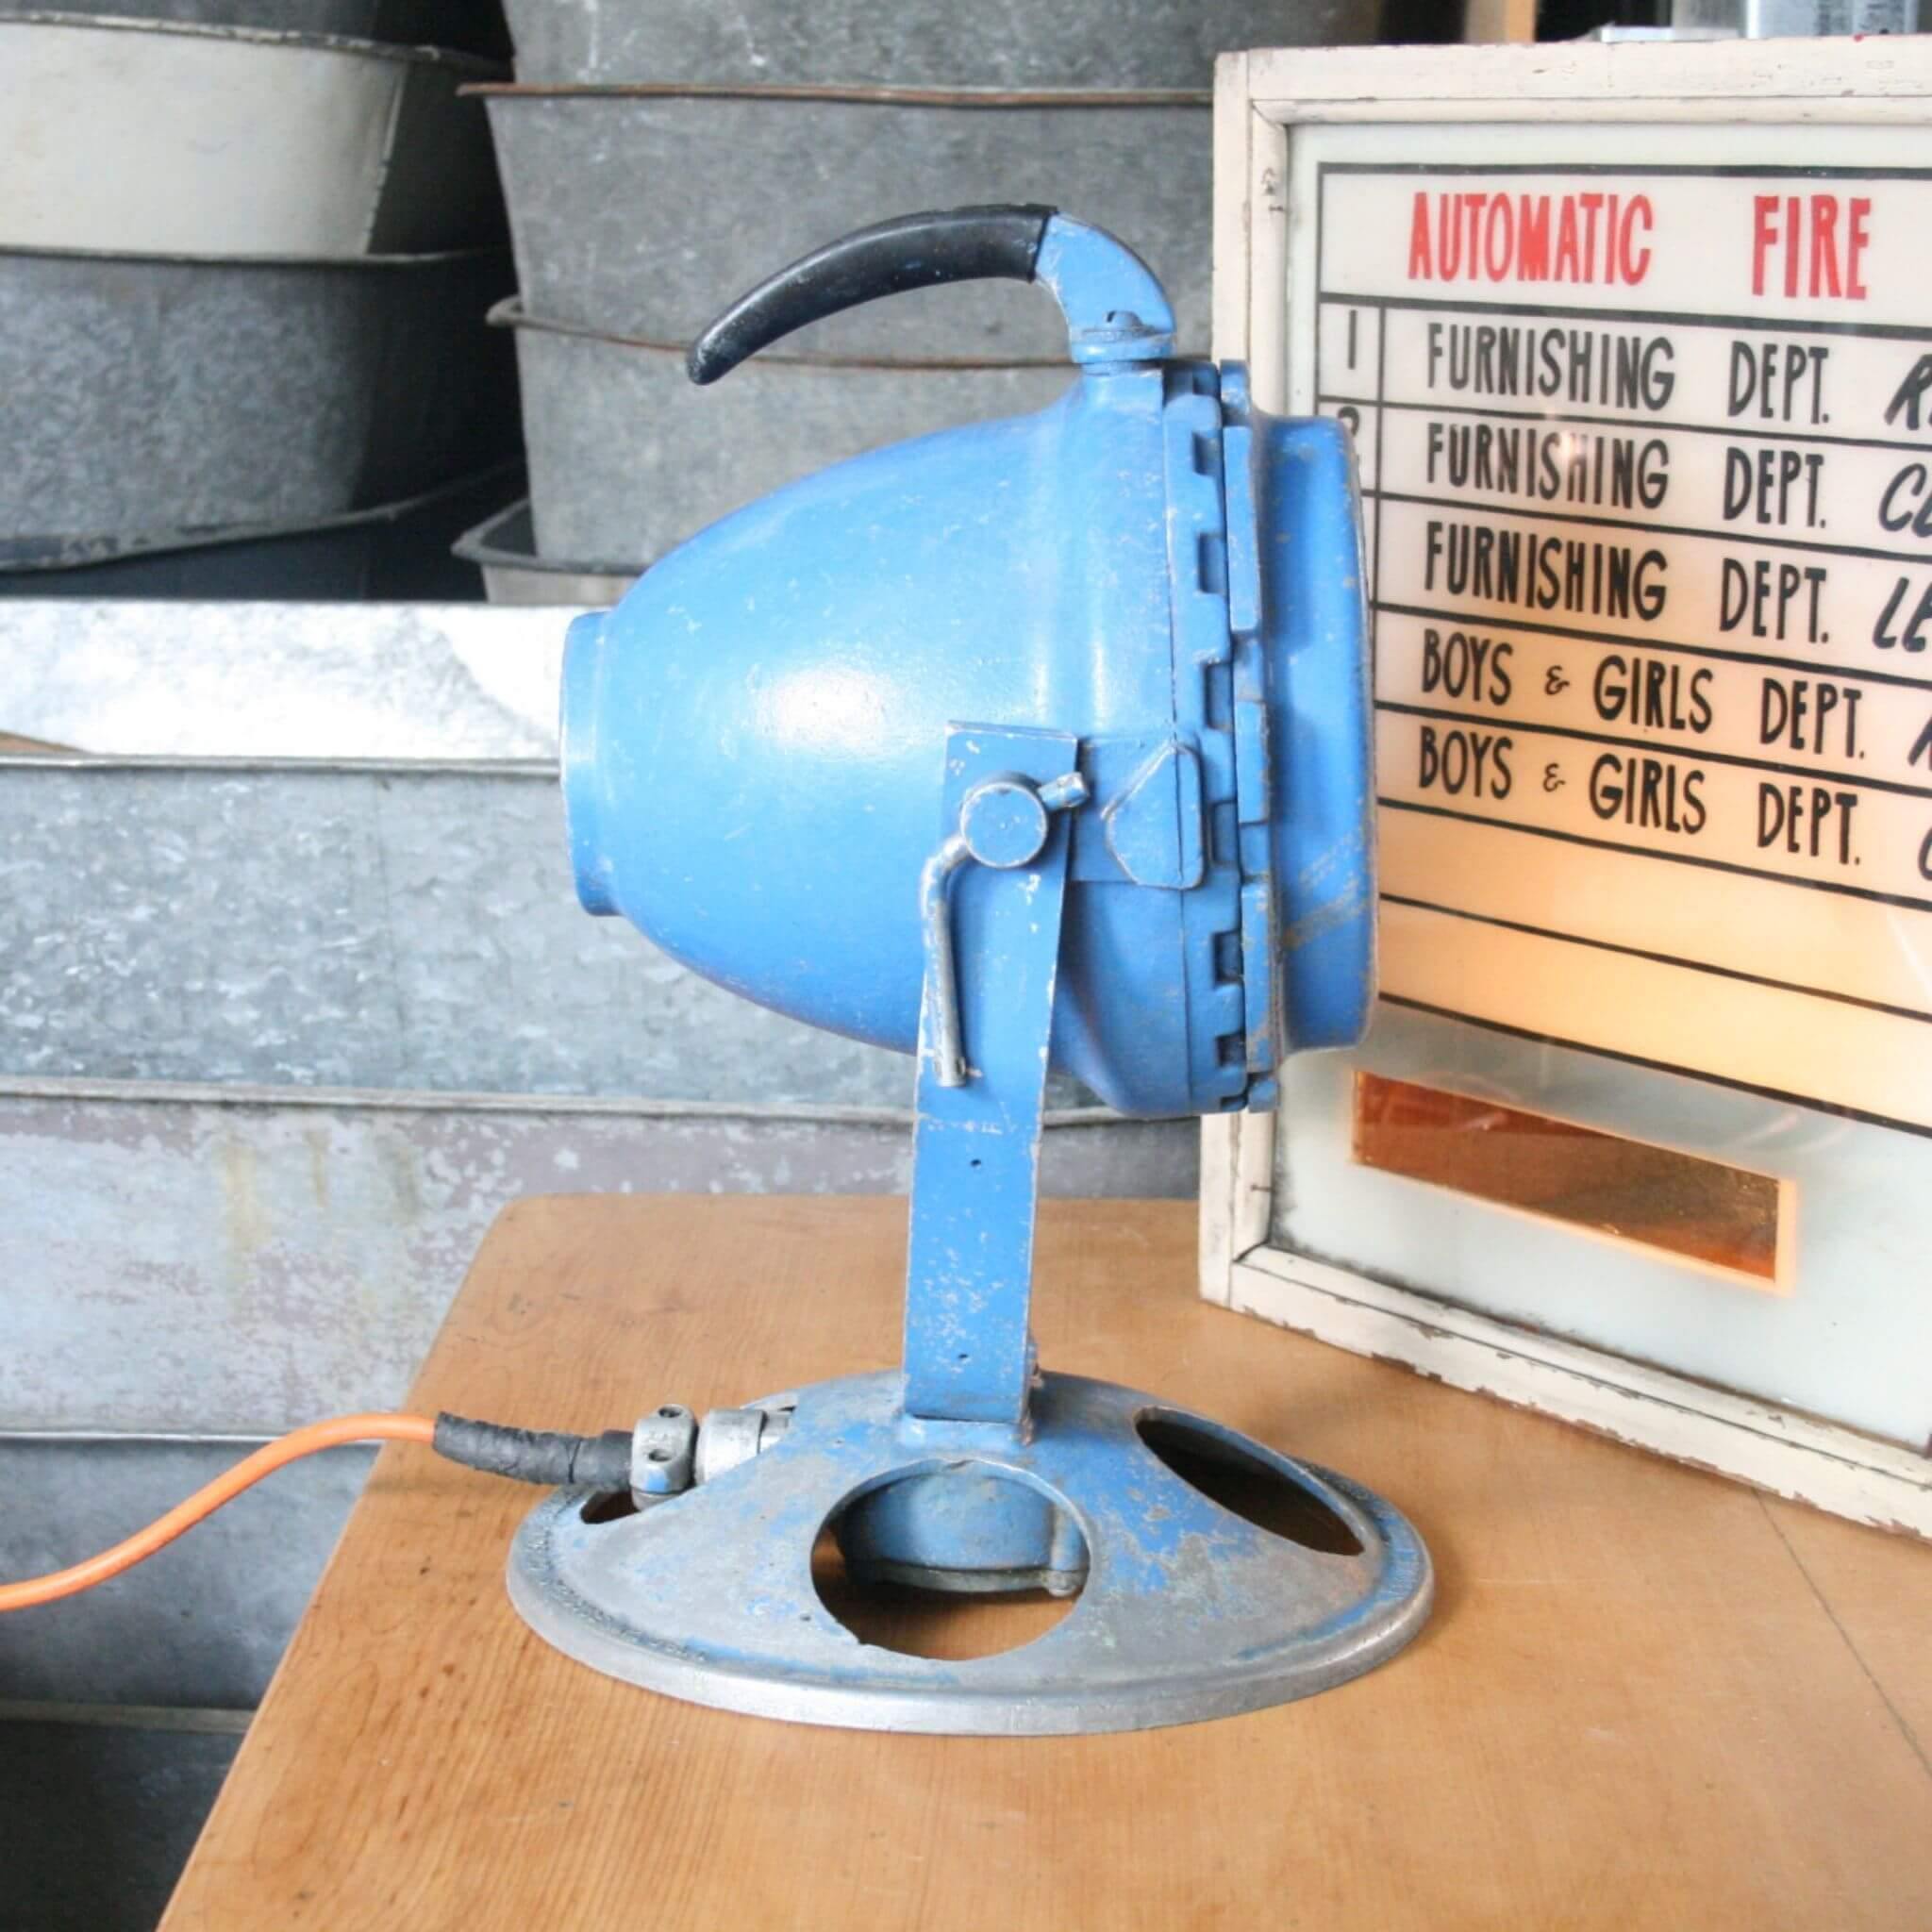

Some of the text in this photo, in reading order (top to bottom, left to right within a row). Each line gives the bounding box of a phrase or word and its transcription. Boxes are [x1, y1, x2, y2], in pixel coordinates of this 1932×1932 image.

[1408, 192, 1872, 300] AUTOMATIC FIRE
[1427, 322, 1675, 411] FURNISHING
[1727, 340, 1830, 425] DEPT.
[1426, 422, 1669, 510] FURNISHING
[1723, 445, 1827, 528] DEPT.
[1424, 521, 1668, 623] FURNISHING
[1718, 557, 1830, 643] DEPT.
[1422, 628, 1514, 707] BOYS
[1544, 664, 1572, 696] &
[1592, 654, 1714, 734] GIRLS
[1759, 676, 1866, 759] DEPT.
[1418, 724, 1514, 800] BOYS
[1541, 761, 1567, 793] &
[1588, 752, 1707, 835] GIRLS
[1757, 781, 1861, 866] DEPT.
